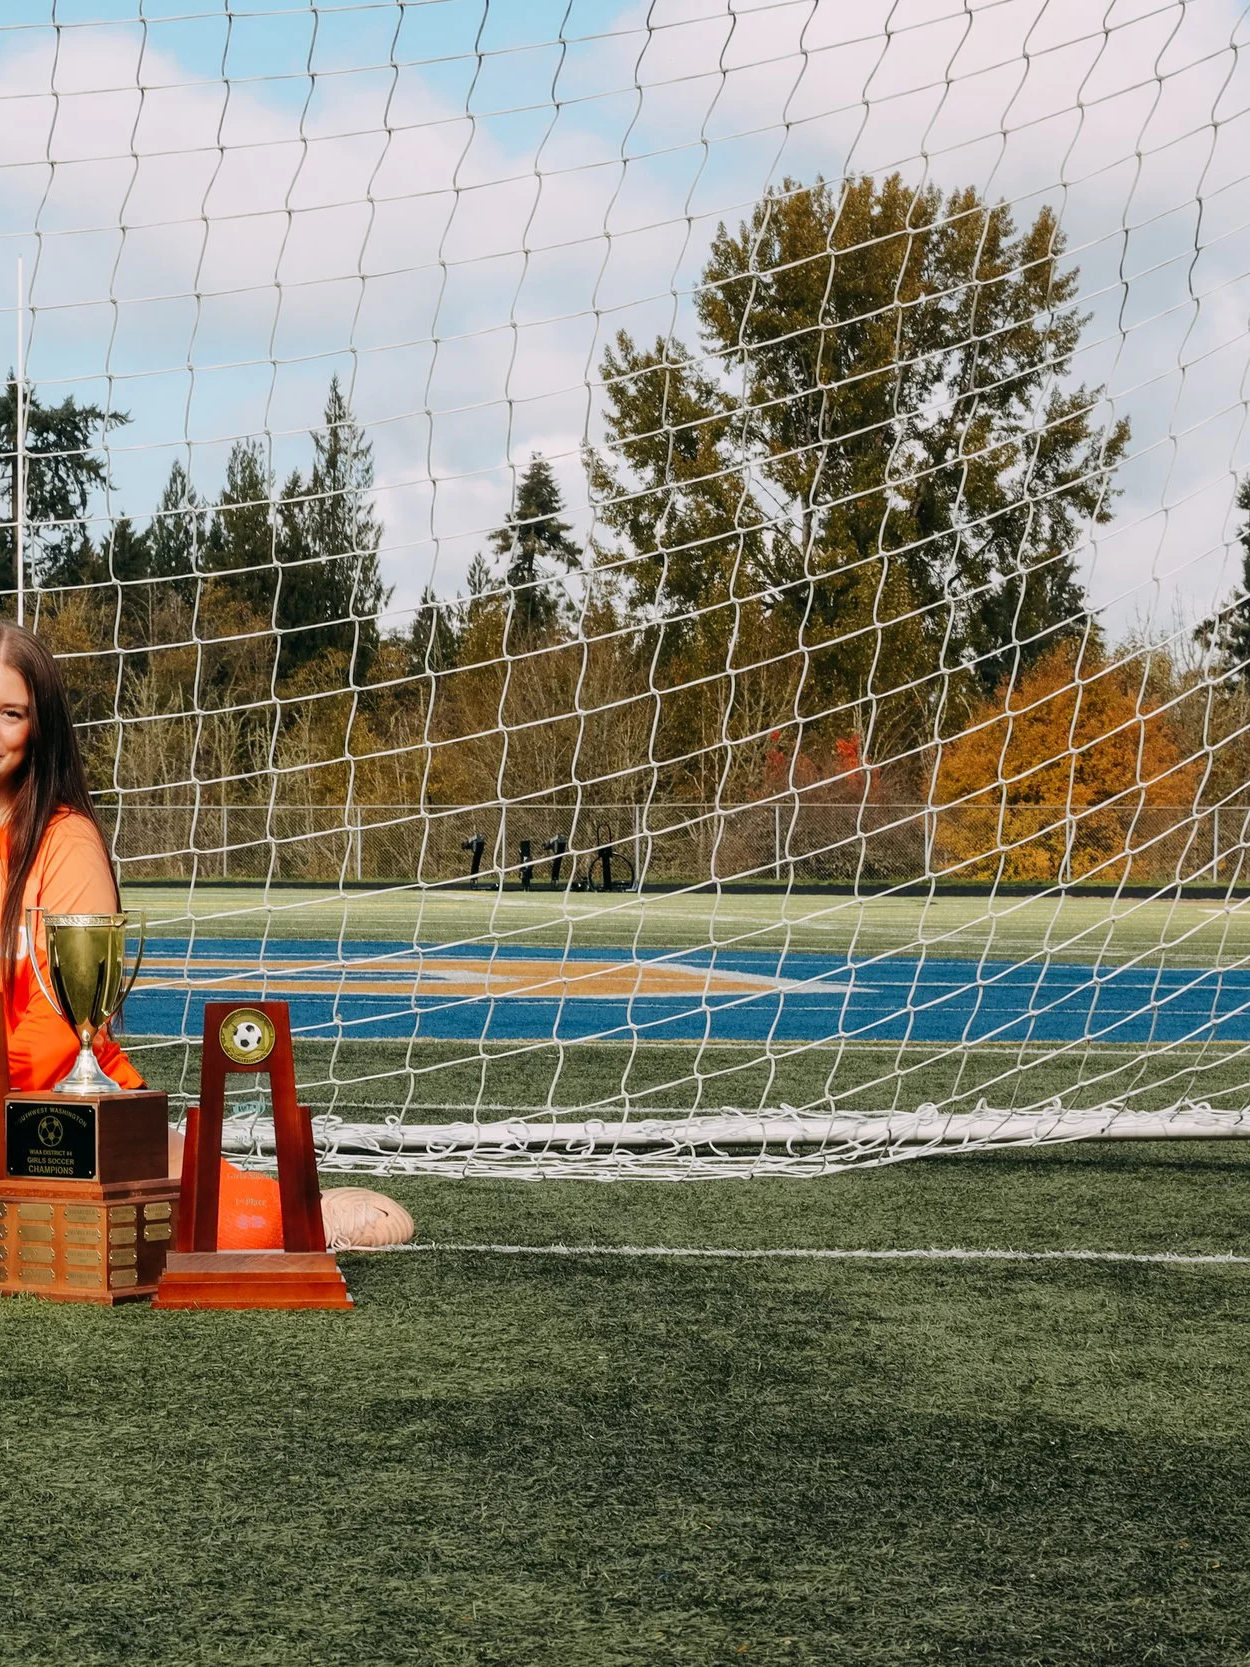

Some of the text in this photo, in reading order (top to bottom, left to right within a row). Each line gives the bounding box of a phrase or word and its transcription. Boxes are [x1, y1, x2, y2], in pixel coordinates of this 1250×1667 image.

[49, 1107, 88, 1128] WASHINGTON
[47, 1157, 75, 1166] SOCCER
[28, 1165, 74, 1176] CHAMPIONS
